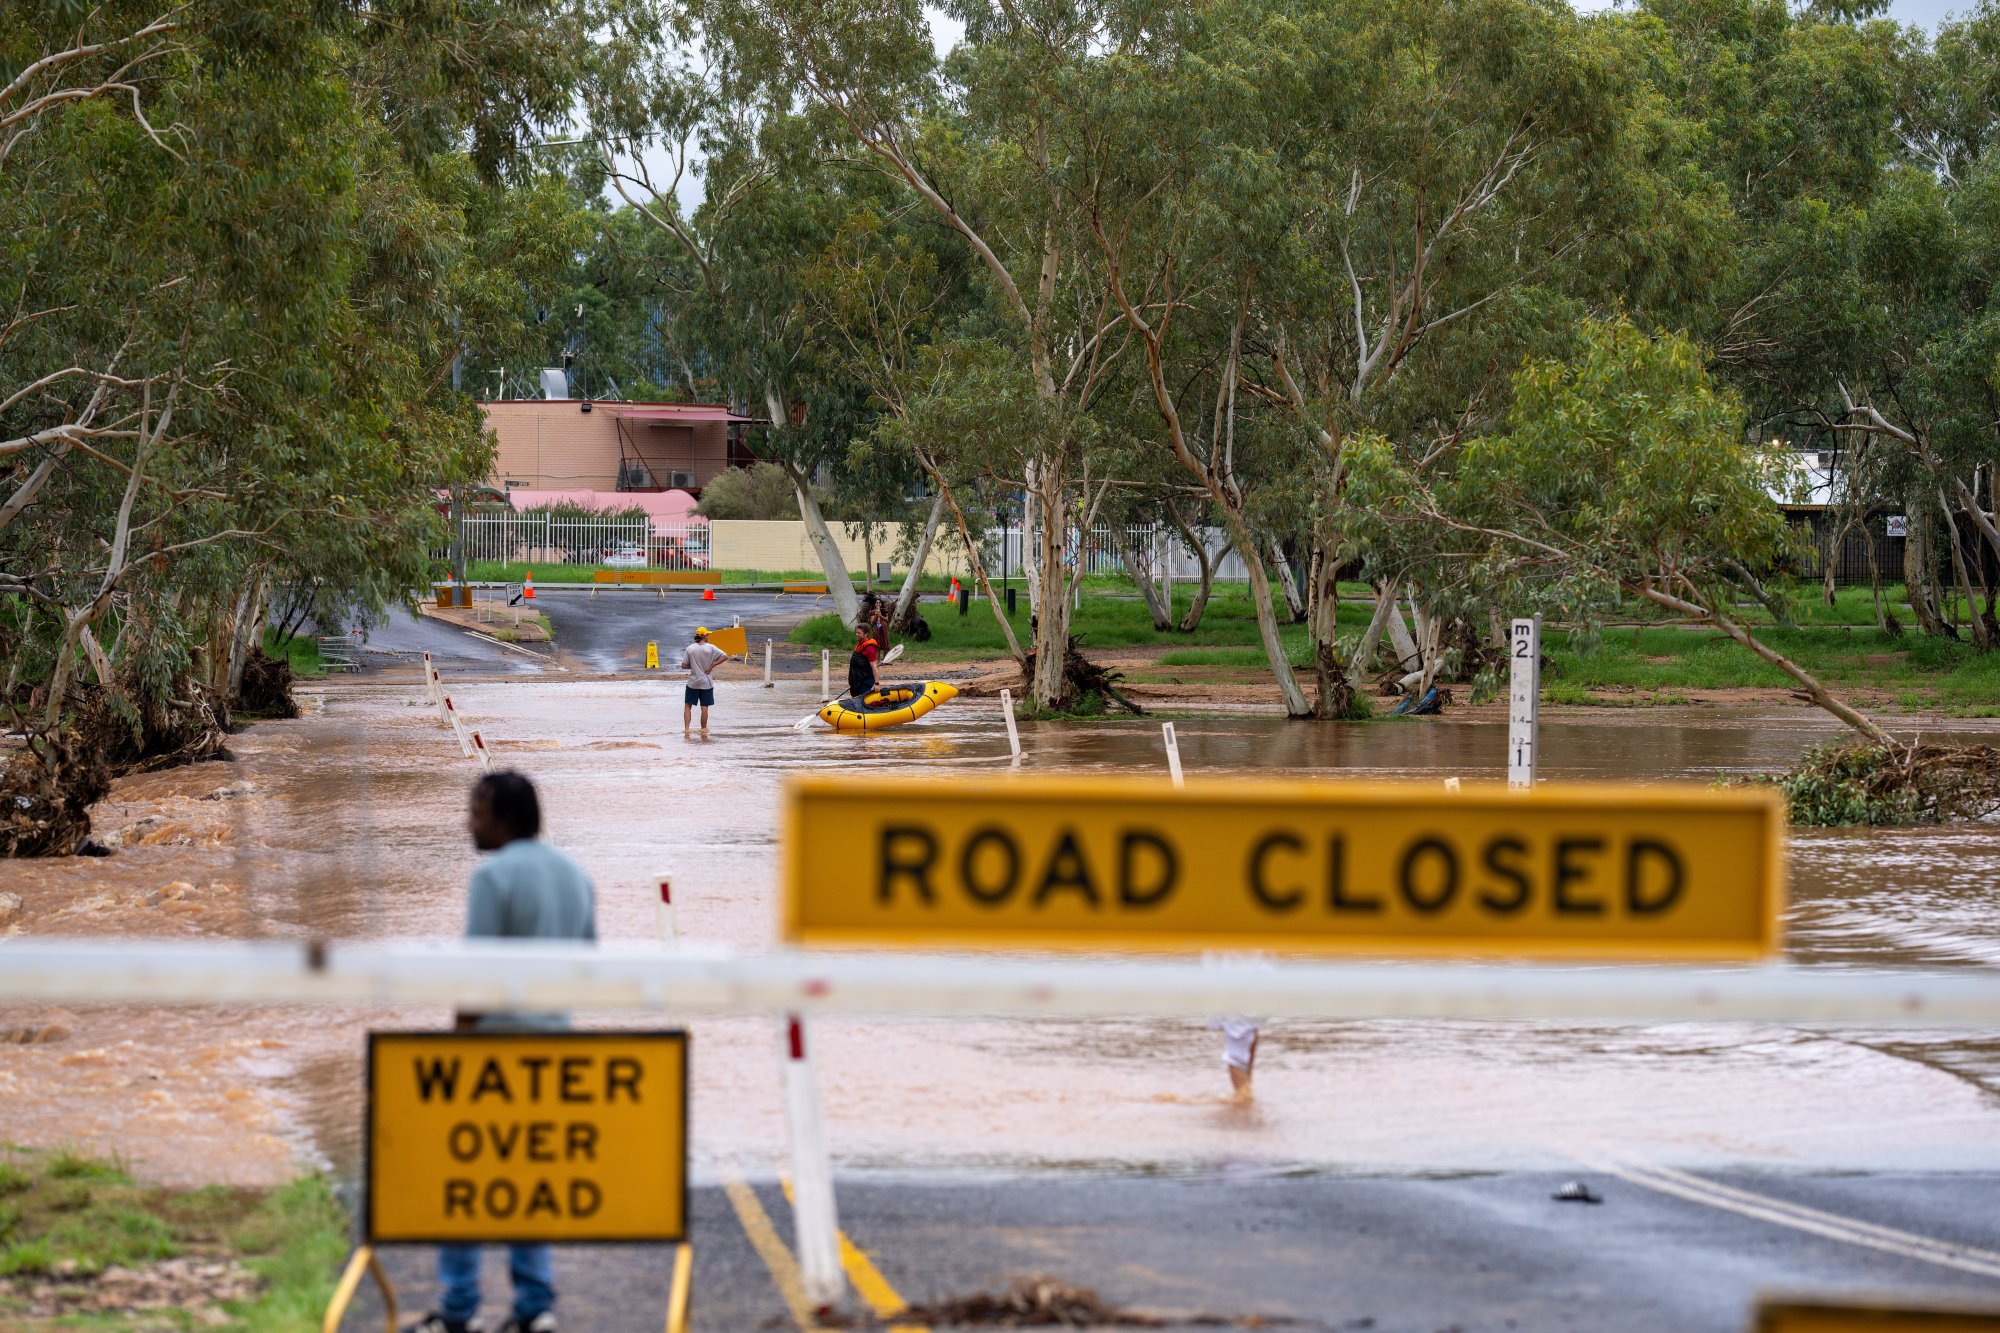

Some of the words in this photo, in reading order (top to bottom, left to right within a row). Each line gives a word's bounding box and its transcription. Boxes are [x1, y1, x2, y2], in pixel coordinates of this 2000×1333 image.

[1515, 624, 1530, 636] m
[1516, 640, 1528, 658] 2
[1517, 748, 1522, 767] 1
[877, 823, 1183, 912] ROAD
[1246, 828, 1691, 920] CLOSED
[412, 1055, 645, 1104] WATER
[448, 1121, 600, 1163] OVER
[444, 1175, 603, 1220] ROAD
